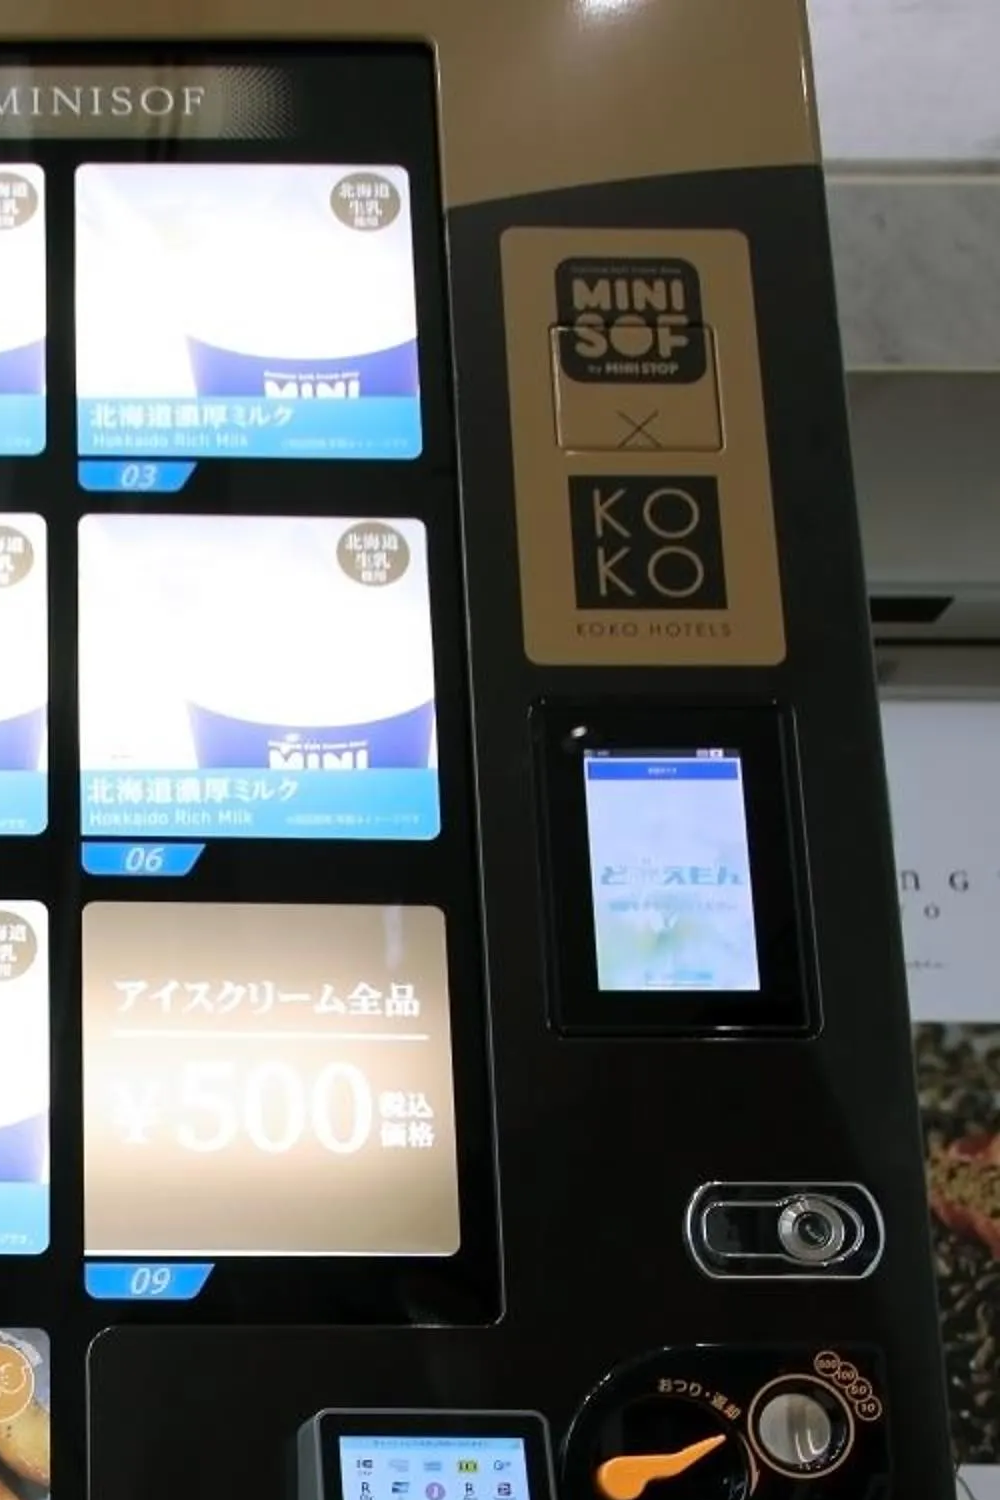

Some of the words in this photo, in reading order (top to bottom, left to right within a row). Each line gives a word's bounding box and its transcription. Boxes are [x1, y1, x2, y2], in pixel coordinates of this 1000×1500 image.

[572, 278, 686, 311] MINI
[574, 313, 690, 358] SOF
[90, 402, 294, 428] 北海道濃厚ミルク
[121, 464, 157, 489] 03
[593, 488, 699, 539] KO
[597, 546, 704, 598] KO
[576, 622, 639, 638] KOKO
[649, 622, 732, 638] HOTELS
[87, 779, 299, 805] 北海道濃厚ミルク
[175, 809, 211, 827] Rich
[218, 809, 253, 826] Milk
[125, 846, 162, 872] 06
[114, 980, 421, 1018] アイスクリーム全品
[379, 1091, 434, 1119] 税込
[380, 1121, 435, 1148] 価格
[130, 1267, 173, 1295] 09
